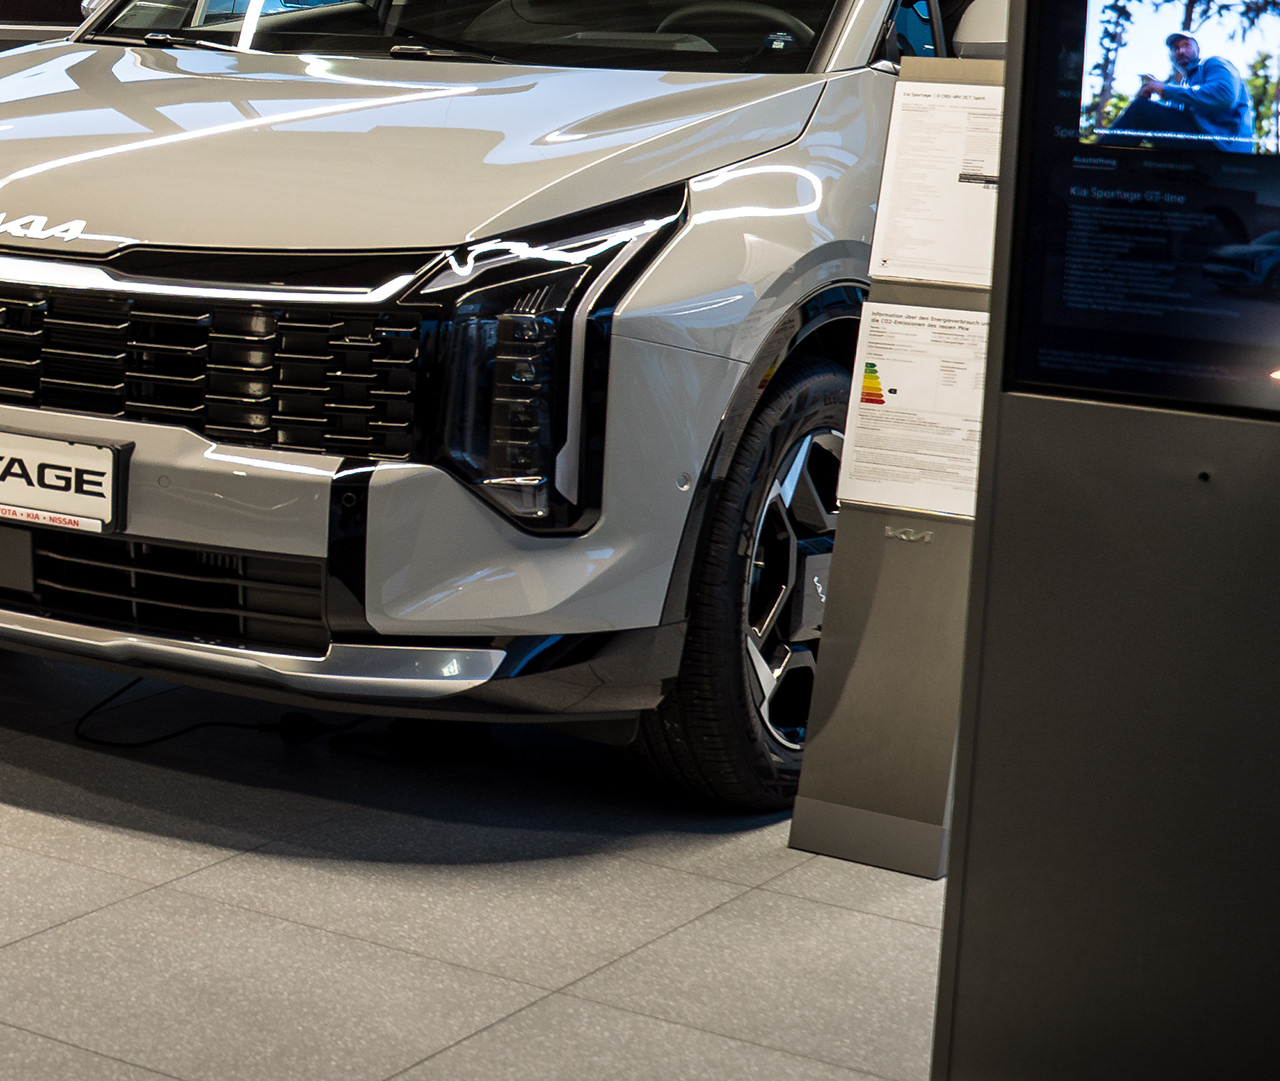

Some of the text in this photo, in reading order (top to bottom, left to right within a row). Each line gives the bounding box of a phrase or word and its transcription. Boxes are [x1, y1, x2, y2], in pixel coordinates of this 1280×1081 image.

[1070, 186, 1088, 197] Kia
[1091, 186, 1141, 201] Sportage
[871, 311, 904, 319] Information
[931, 316, 980, 326] Energieverbrauch
[26, 512, 40, 521] KIA
[49, 515, 80, 527] NISSAN
